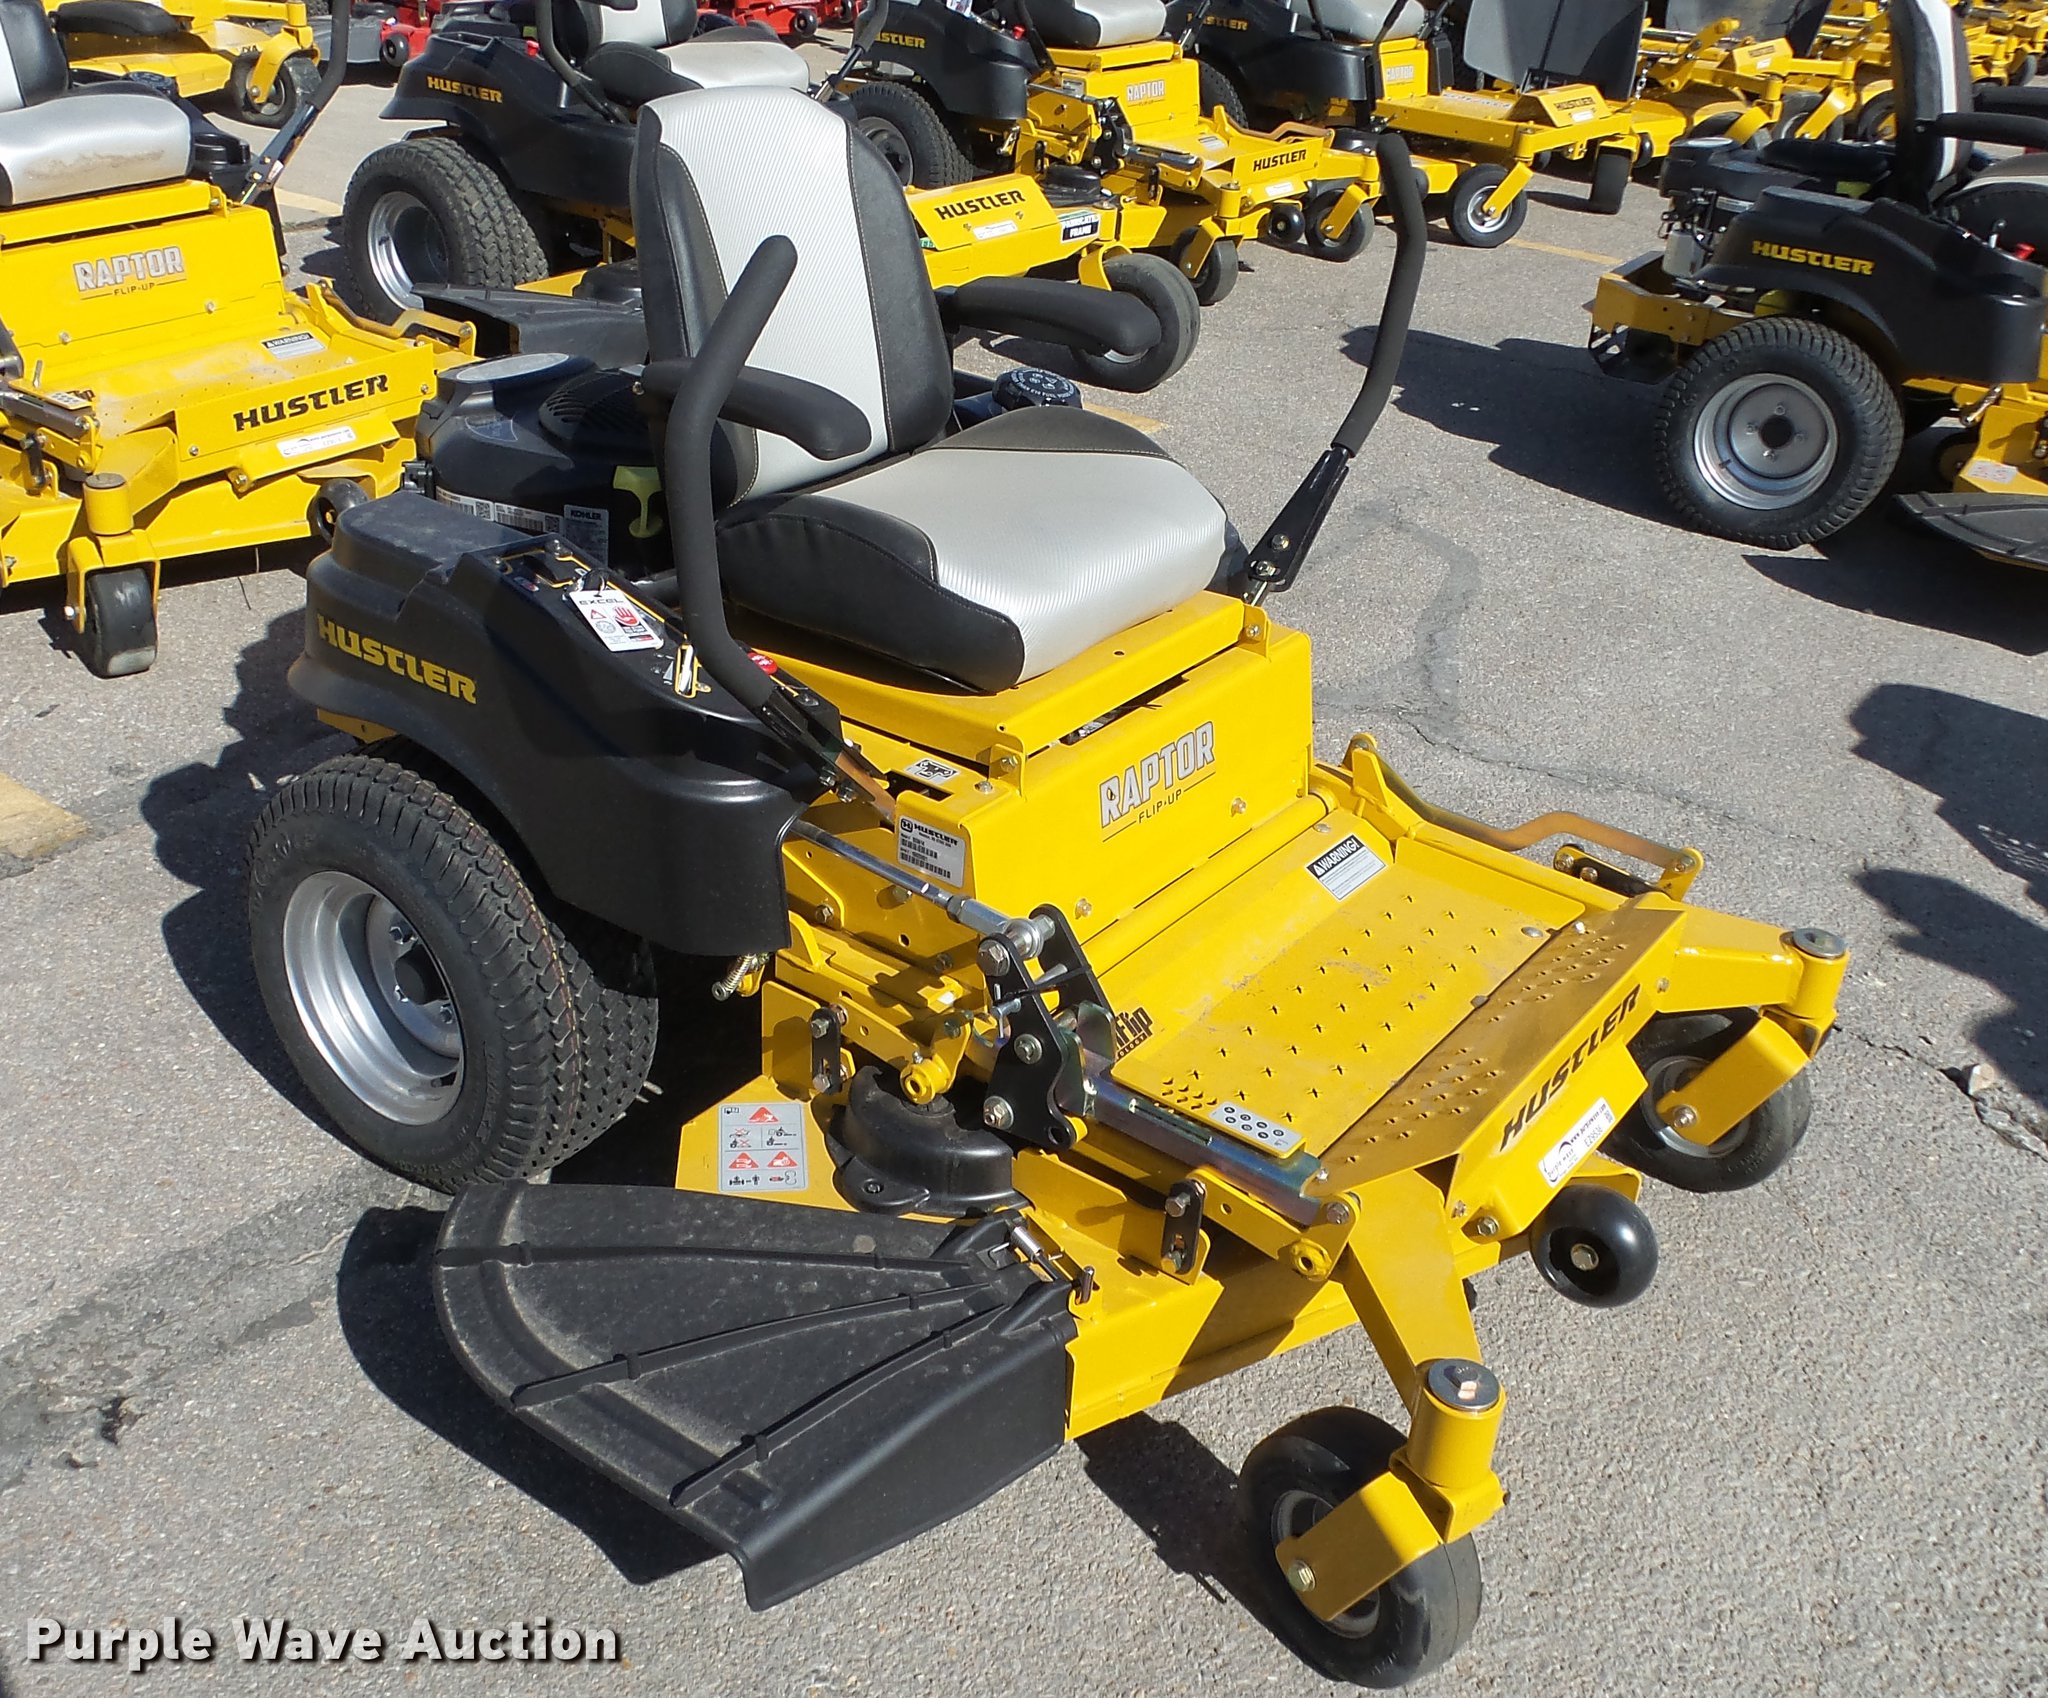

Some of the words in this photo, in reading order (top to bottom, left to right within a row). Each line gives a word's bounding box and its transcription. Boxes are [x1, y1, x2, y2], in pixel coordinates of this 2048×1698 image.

[427, 76, 503, 103] HUSTLER
[1126, 80, 1165, 101] RAPTOR
[1253, 149, 1307, 172] HUSTLER
[935, 190, 1025, 220] HUSTLER
[73, 246, 184, 292] RAPTOR
[1752, 241, 1875, 275] HUSTLER
[233, 374, 388, 432] HUSTLER
[570, 510, 602, 520] KOHLER
[317, 613, 477, 704] HUSTLER
[1099, 721, 1215, 829] RAPTOR
[914, 823, 958, 846] HUSTLER
[1318, 838, 1360, 871] WARNING!
[1500, 984, 1641, 1152] HUSTLER
